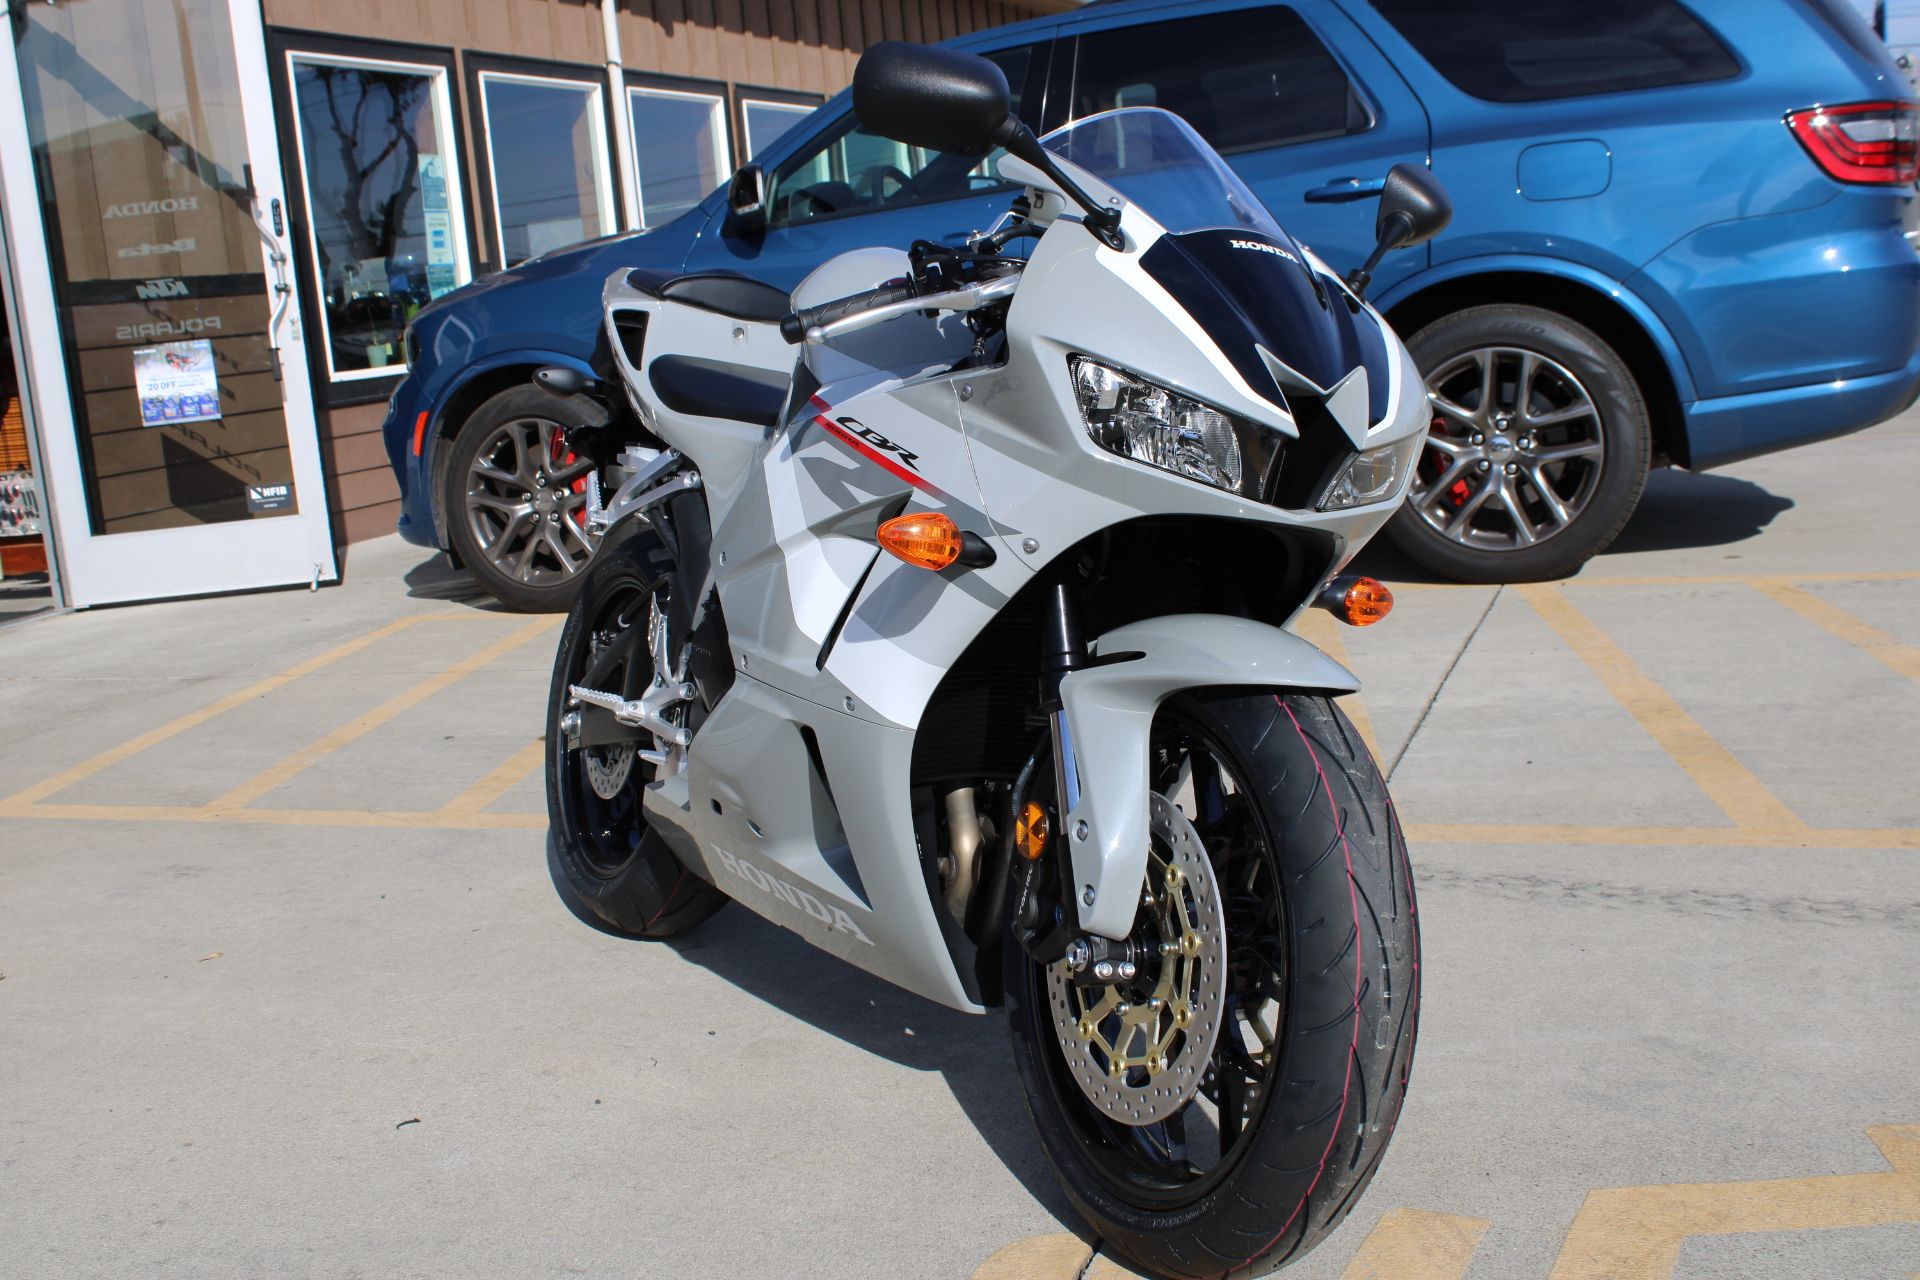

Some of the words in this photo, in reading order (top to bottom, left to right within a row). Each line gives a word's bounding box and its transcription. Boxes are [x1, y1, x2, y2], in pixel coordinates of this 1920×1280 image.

[1229, 239, 1299, 264] HONDA
[835, 416, 920, 472] CBR
[262, 486, 288, 497] NFIB
[710, 843, 876, 946] HONDA
